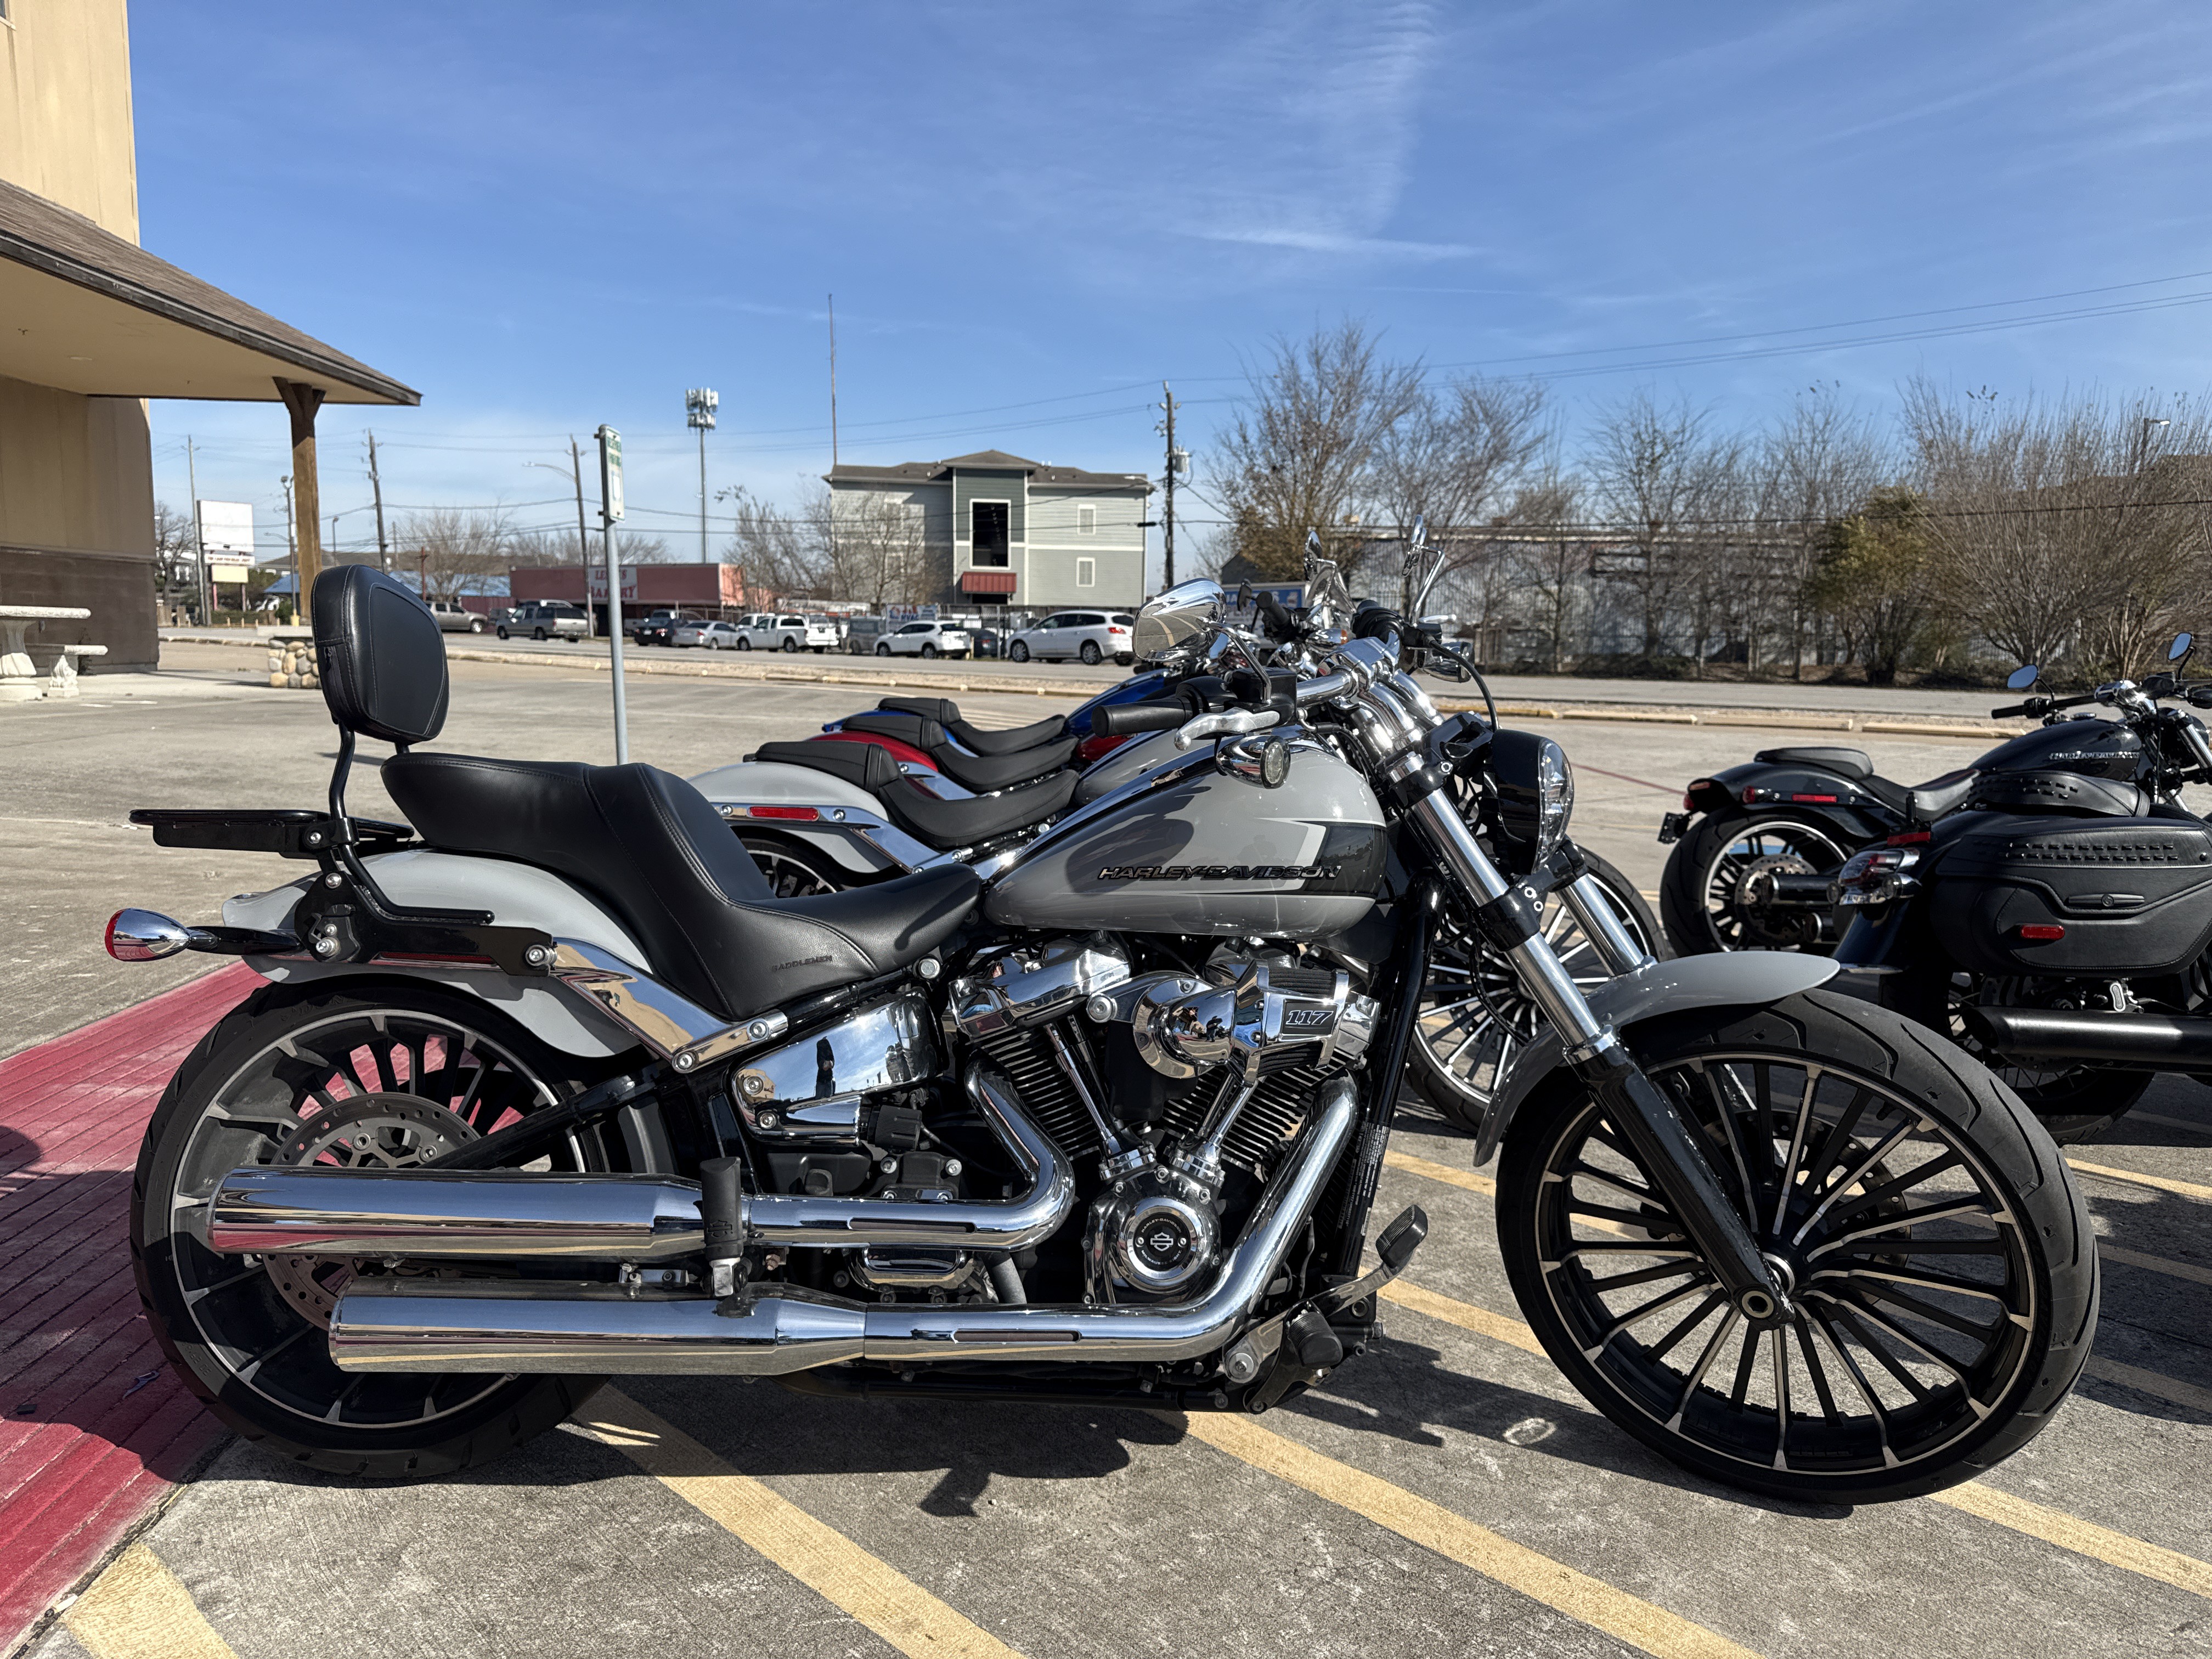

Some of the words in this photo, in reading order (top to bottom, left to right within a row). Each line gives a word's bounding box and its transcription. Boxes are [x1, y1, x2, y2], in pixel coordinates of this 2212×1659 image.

[1097, 865, 1342, 880] HARLEY-DAVIDSON
[771, 955, 833, 971] SADDLEMEN
[1285, 1009, 1334, 1025] 117
[1141, 1218, 1182, 1233] HARLEY-DAVIDSON
[1141, 1250, 1168, 1265] MILWAUKEE
